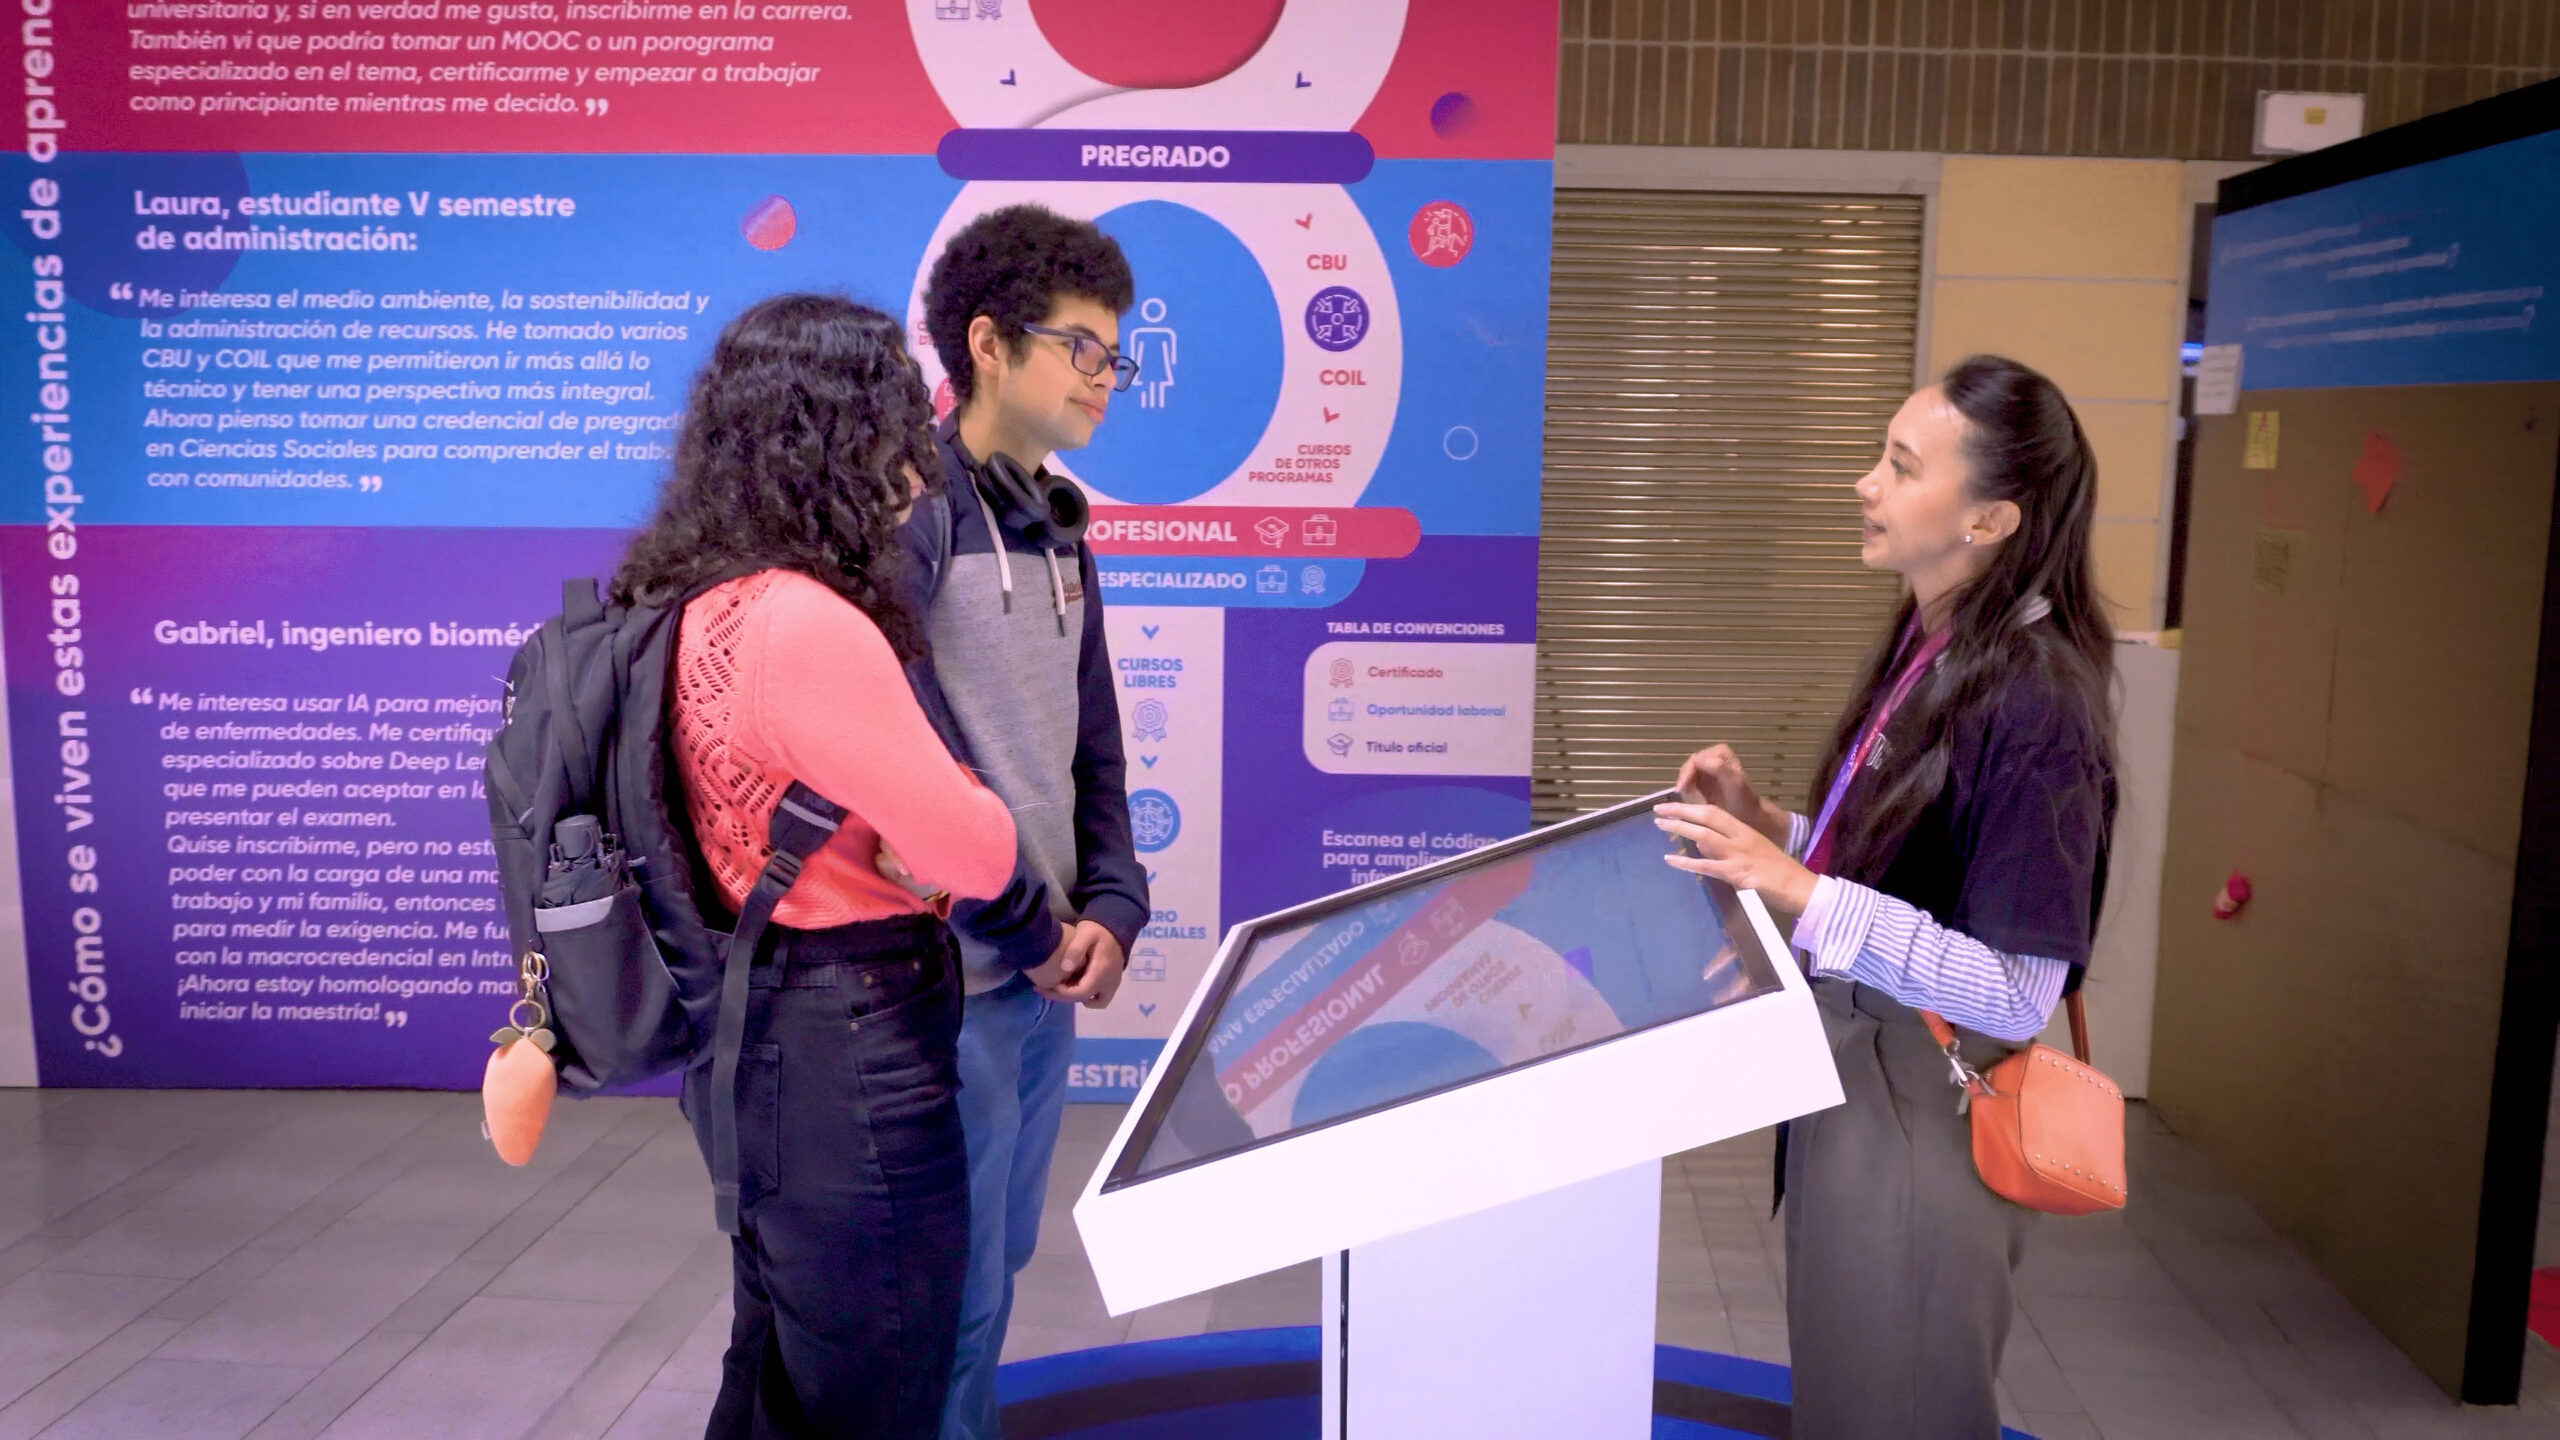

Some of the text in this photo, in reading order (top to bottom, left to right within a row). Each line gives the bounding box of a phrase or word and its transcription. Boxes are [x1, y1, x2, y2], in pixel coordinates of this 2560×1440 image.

[127, 0, 852, 24] universitaria en verdad me gusta, inscribirme en carrera.
[129, 30, 774, 56] También que podría tomar un MOOC un porograma
[129, 60, 820, 87] especializado en tema, certificarme empezar trabajar
[129, 92, 579, 116] como principiante mientras me decido.
[1082, 145, 1230, 168] PREGRADO
[21, 177, 61, 240] de
[135, 190, 575, 219] Laura, estudiante V semestre
[136, 225, 417, 251] de administración:
[1307, 254, 1347, 270] CBU
[139, 289, 690, 312] Me interesa medio ambiente, sostenibilidad
[168, 319, 688, 340] administración de recursos. He tomado varios
[142, 349, 623, 373] CBU COIL que me permitieron más allá
[1319, 369, 1366, 385] COIL
[144, 379, 654, 405] técnico tener una perspectiva más integral.
[25, 253, 85, 560] experiencias
[143, 409, 214, 427] Ahora
[217, 409, 294, 432] pienso
[299, 412, 369, 429] tomar
[373, 415, 417, 429] una
[423, 411, 544, 429] credencial
[549, 411, 579, 430] de
[146, 439, 584, 463] en Ciencias Sociales para comprender
[1298, 445, 1351, 455] CURSOS
[1276, 458, 1340, 469] DE OTROS
[147, 469, 353, 488] con comunidades.
[1248, 470, 1333, 483] PROGRAMAS
[1098, 572, 1247, 588] ESPECIALIZADO
[47, 572, 86, 697] estas
[154, 620, 422, 651] Gabriel, ingeniero
[1327, 622, 1504, 635] TABLA DE CONVENCIONES
[1117, 658, 1183, 671] CURSOS
[1368, 666, 1443, 678] Certificado
[1124, 675, 1176, 688] LIBRES
[159, 693, 193, 711] Me
[198, 693, 287, 711] interesa
[293, 698, 343, 712] usar
[347, 694, 369, 712] IA
[374, 698, 429, 716] para
[1367, 704, 1506, 717] Oportunidad laboral
[160, 721, 402, 741] de enfermedades. Me
[1407, 742, 1447, 753] oficial
[54, 709, 95, 833] viven
[162, 750, 450, 774] especializado sobre Deep
[164, 783, 207, 801] que
[212, 783, 247, 797] me
[252, 780, 338, 801] pueden
[343, 782, 434, 802] aceptar
[438, 785, 466, 798] en
[165, 809, 396, 829] presentar examen.
[168, 835, 452, 859] Quise inscribirme, pero no
[1322, 830, 1404, 848] Escanea
[1408, 832, 1425, 848] el
[67, 844, 99, 894] se
[1322, 852, 1370, 869] para
[169, 864, 237, 885] poder
[241, 868, 282, 882] con
[314, 869, 380, 887] carga
[386, 865, 415, 883] de
[421, 870, 463, 883] una
[172, 892, 496, 914] trabajo familia, entonces
[173, 920, 478, 943] para medir exigencia. Me
[1137, 926, 1206, 940] NCIALES
[175, 948, 466, 966] con macrocredencial en
[68, 905, 124, 1060] ¿Cómo
[178, 974, 473, 998] ¡Ahora estoy homologando
[180, 1001, 380, 1020] iniciar maestría!
